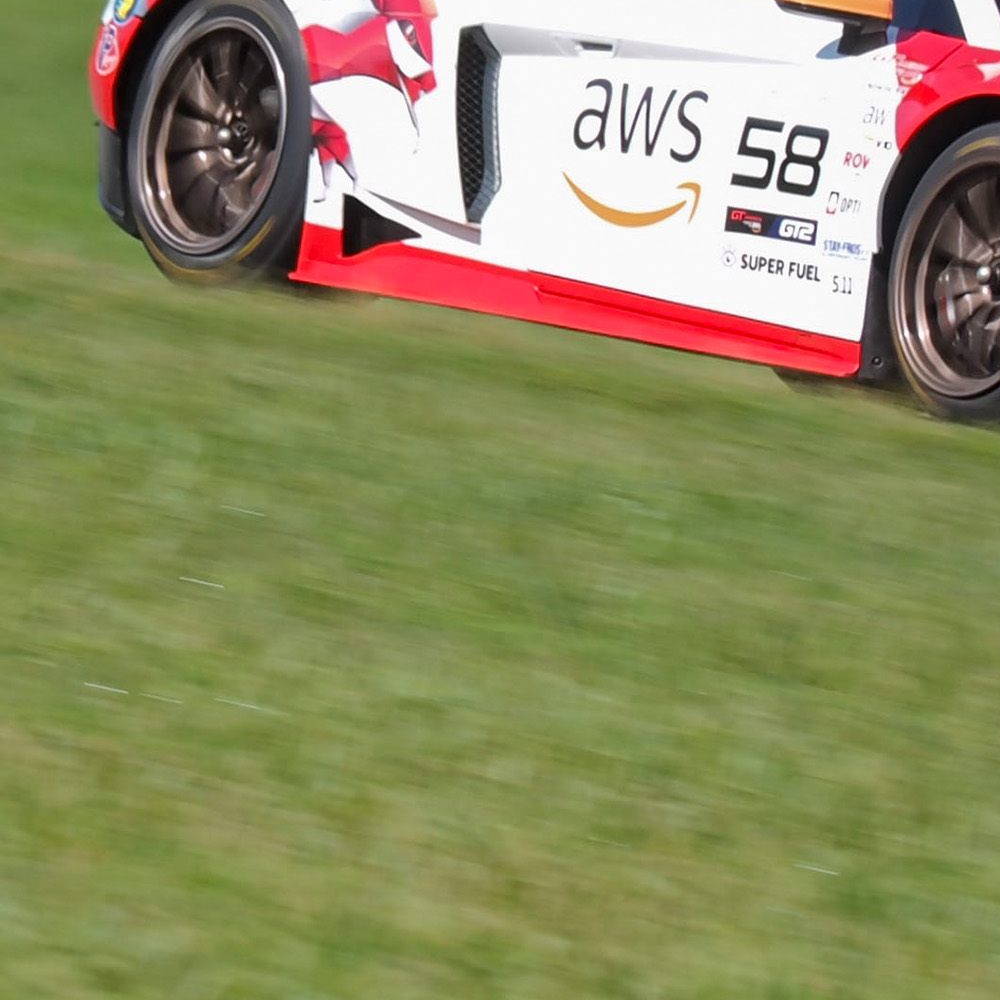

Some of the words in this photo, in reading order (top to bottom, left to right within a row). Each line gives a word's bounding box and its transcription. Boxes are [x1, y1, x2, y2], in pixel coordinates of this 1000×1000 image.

[573, 78, 709, 163] aws
[730, 116, 830, 198] 58
[778, 218, 816, 242] GT2
[740, 253, 785, 276] SUPER
[788, 261, 821, 282] FUEL
